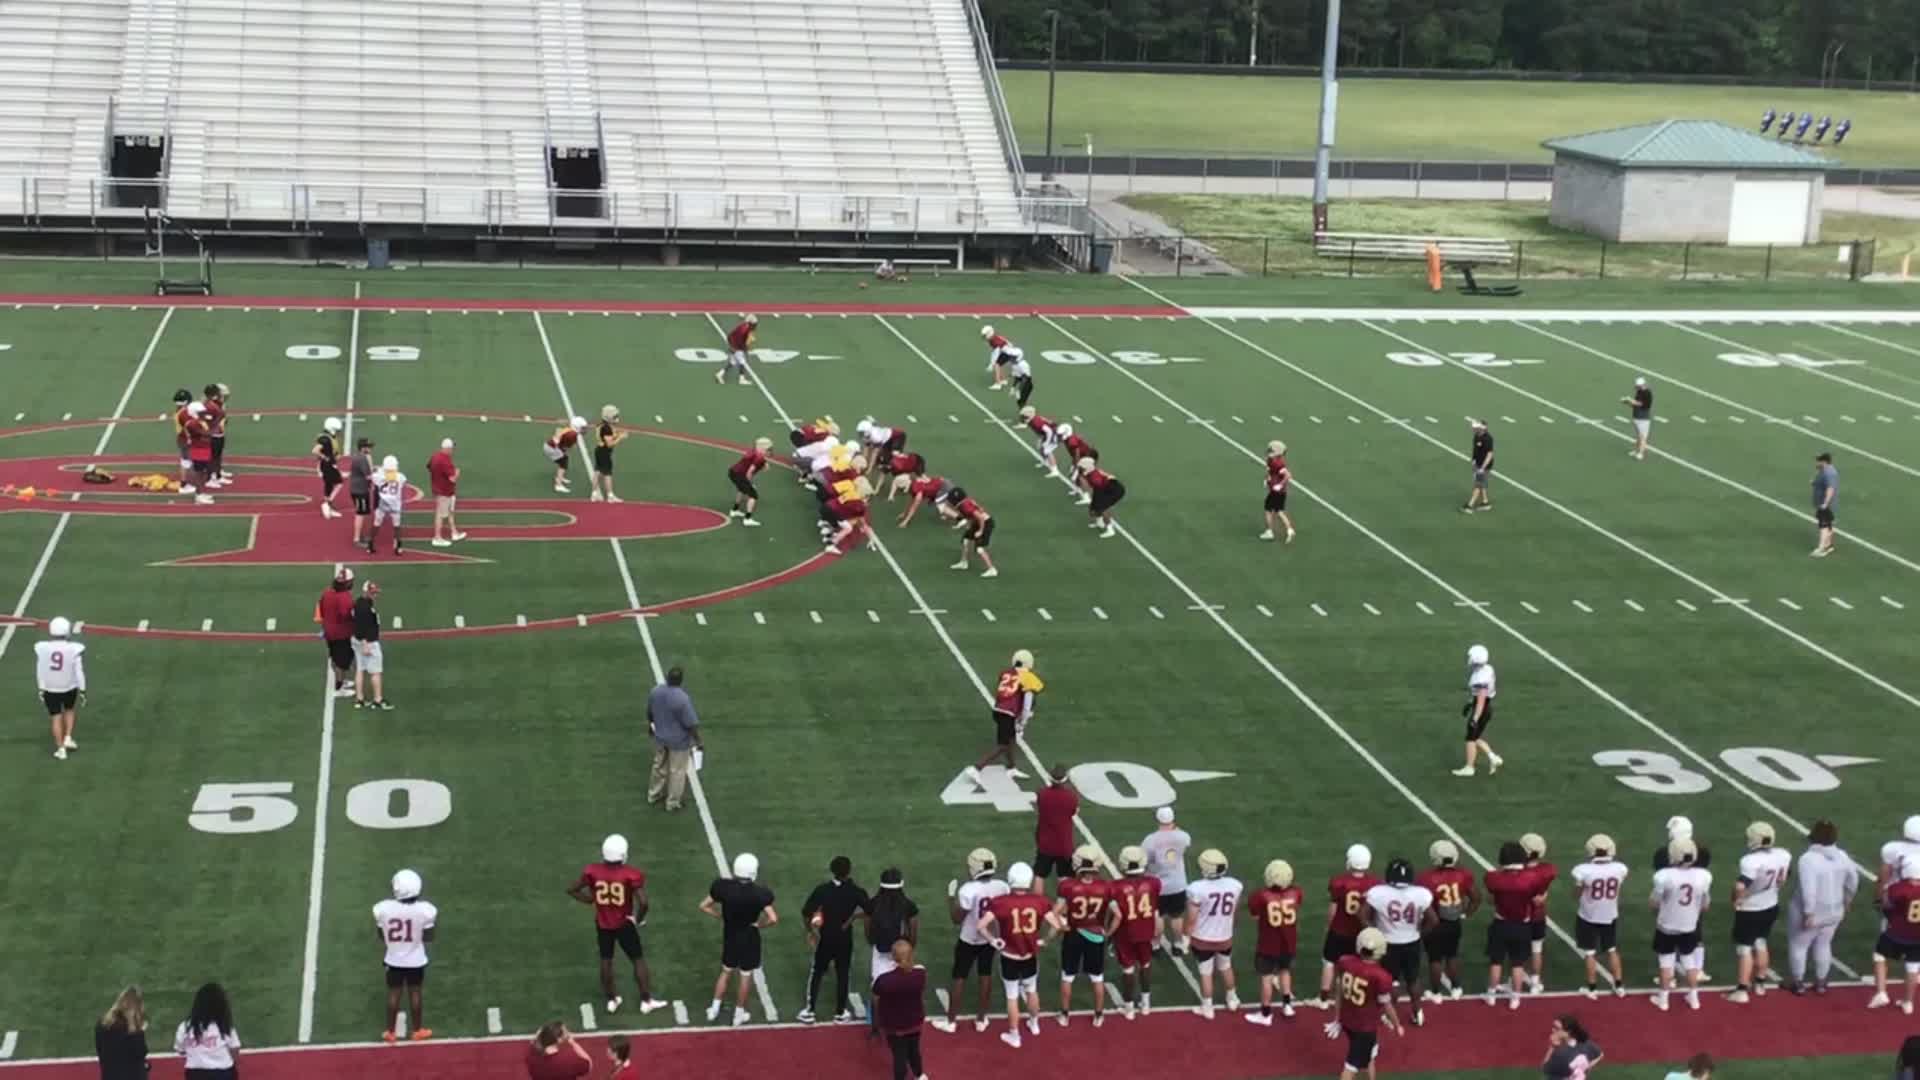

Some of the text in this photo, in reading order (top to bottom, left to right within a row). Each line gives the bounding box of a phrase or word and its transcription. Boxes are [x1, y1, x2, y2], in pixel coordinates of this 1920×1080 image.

[50, 651, 64, 671] 9
[1592, 747, 1841, 795] 30
[940, 762, 1177, 812] 40
[188, 779, 451, 834] 50
[595, 881, 625, 907] 29
[1437, 882, 1461, 906] 31
[1592, 877, 1618, 900] 88
[1678, 883, 1693, 906] 3
[1071, 896, 1103, 919] 37
[1126, 893, 1153, 920] 14
[1208, 892, 1235, 916] 76
[1267, 898, 1297, 928] 65
[1387, 900, 1416, 923] 64
[388, 918, 414, 943] 21
[1011, 907, 1038, 934] 13
[1342, 971, 1369, 1007] 85
